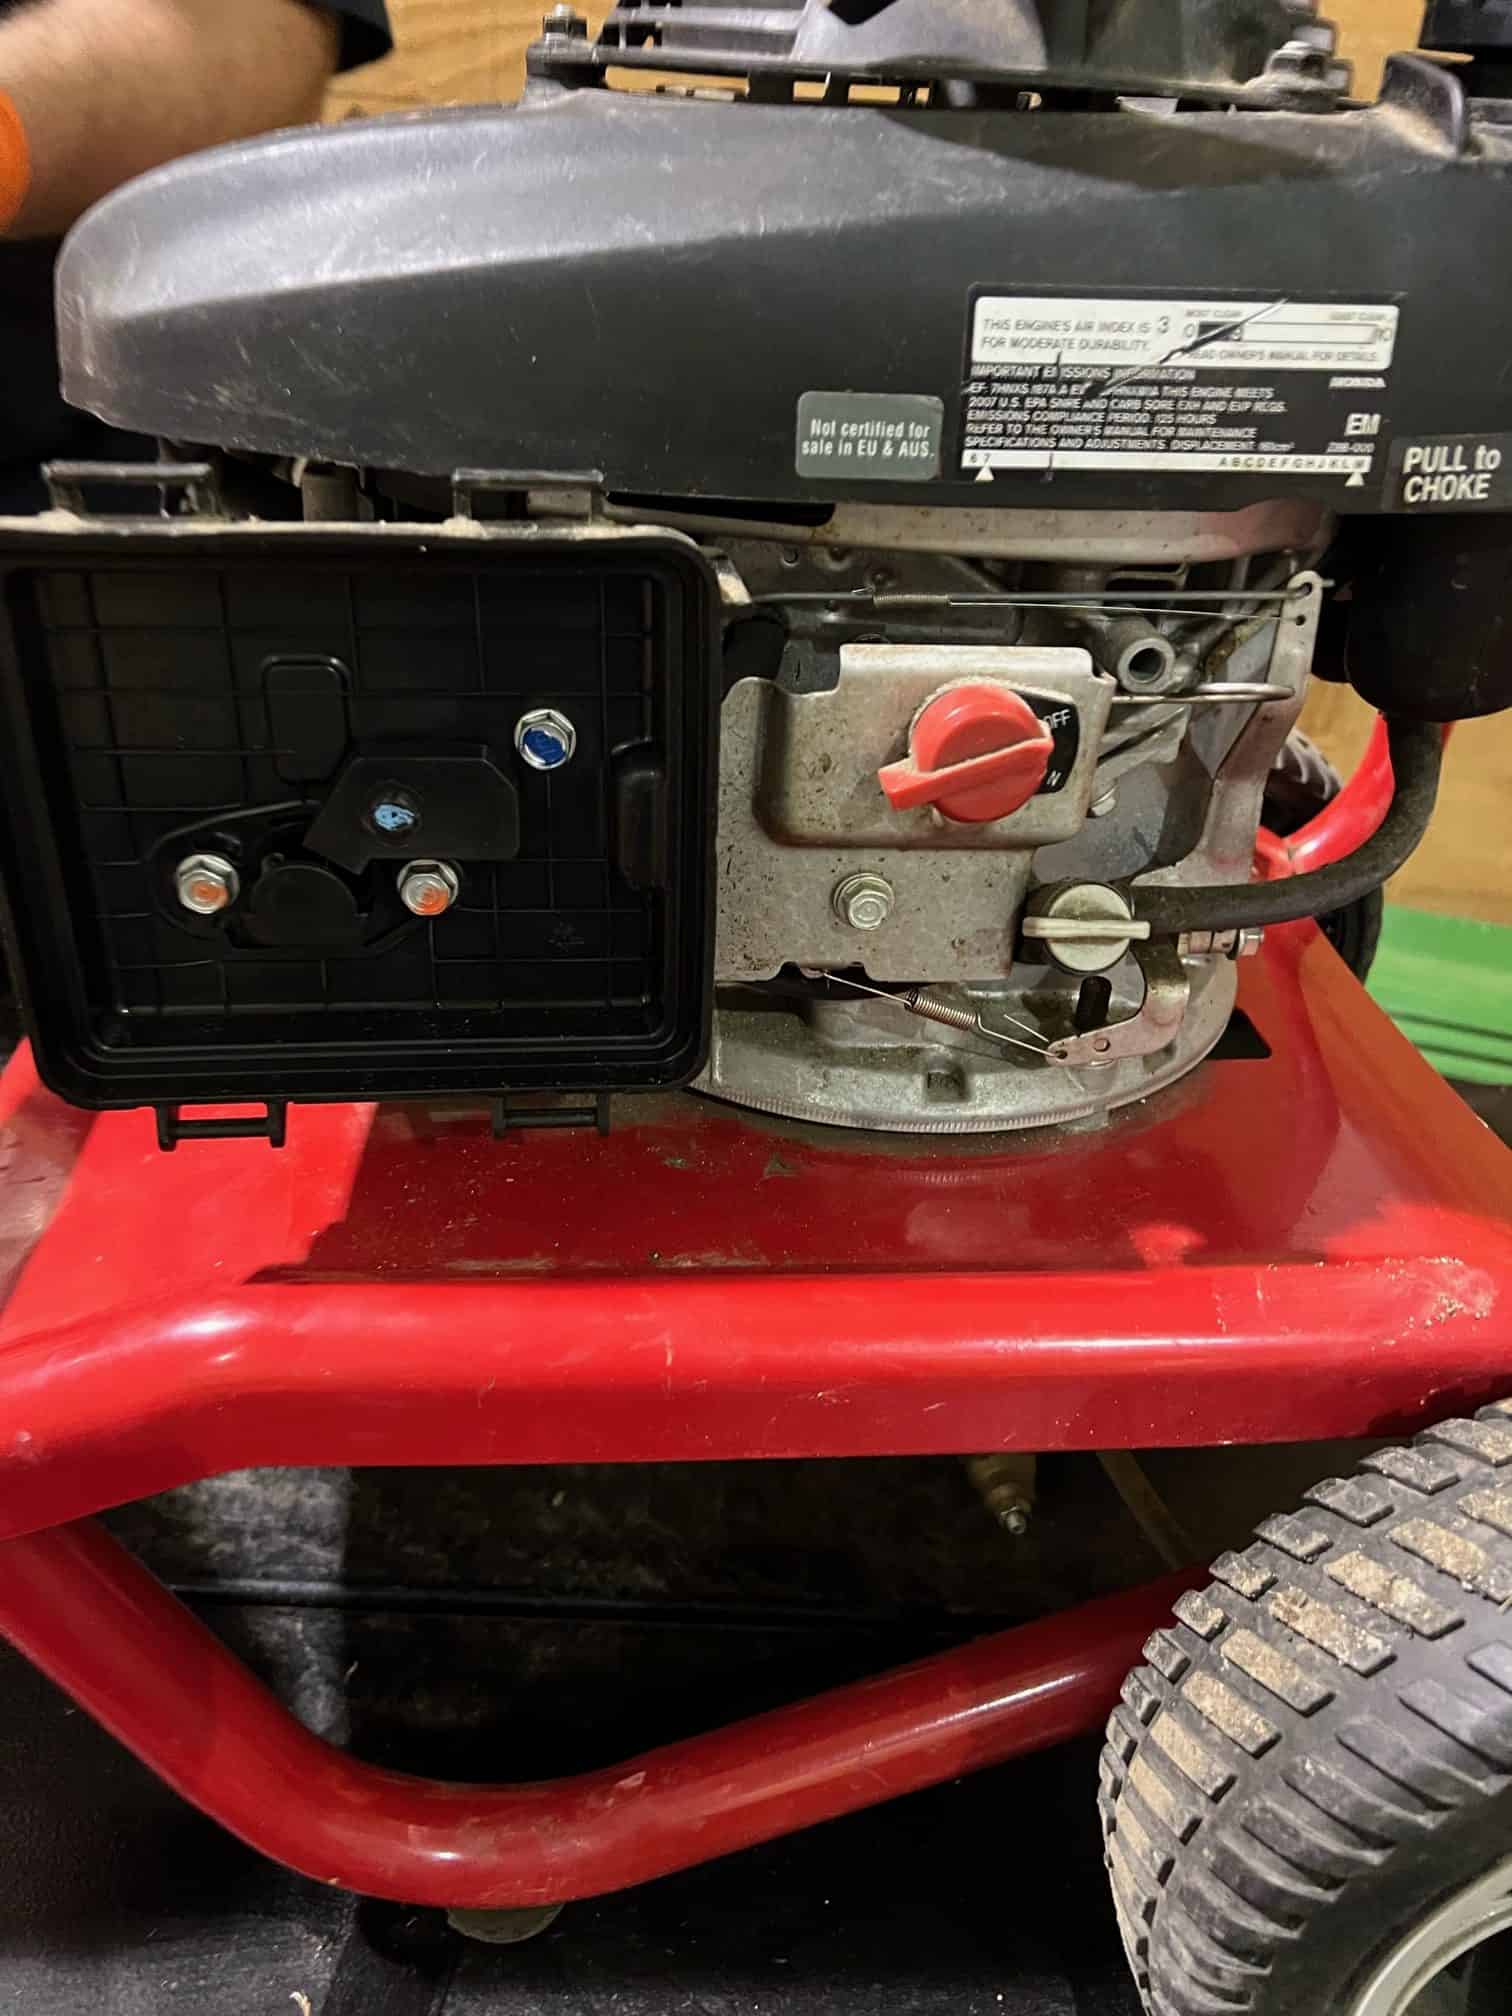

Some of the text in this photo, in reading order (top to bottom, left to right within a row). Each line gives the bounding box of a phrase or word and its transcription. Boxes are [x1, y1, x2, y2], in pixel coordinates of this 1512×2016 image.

[983, 318, 1010, 331] THIS
[1157, 315, 1170, 333] 3
[981, 336, 1009, 348] FOR
[1009, 337, 1077, 350] MODERATE
[970, 365, 1041, 379] IMPORTANT
[968, 396, 998, 409] 2007
[966, 409, 1031, 422] EMISSIONS
[1031, 411, 1106, 424] COMPLIANCE
[1176, 413, 1218, 425] HOURS
[810, 418, 932, 439] Not certified for
[965, 422, 1005, 435] REFER
[1006, 422, 1024, 435] TO
[1025, 423, 1050, 436] THE
[1151, 426, 1177, 438] FOR
[801, 438, 936, 458] sale in EU & AUS.
[964, 436, 1058, 449] SPECIFICATIONS
[1058, 438, 1085, 450] AND
[1402, 444, 1502, 474] PULL to
[1403, 473, 1493, 503] CHOKE
